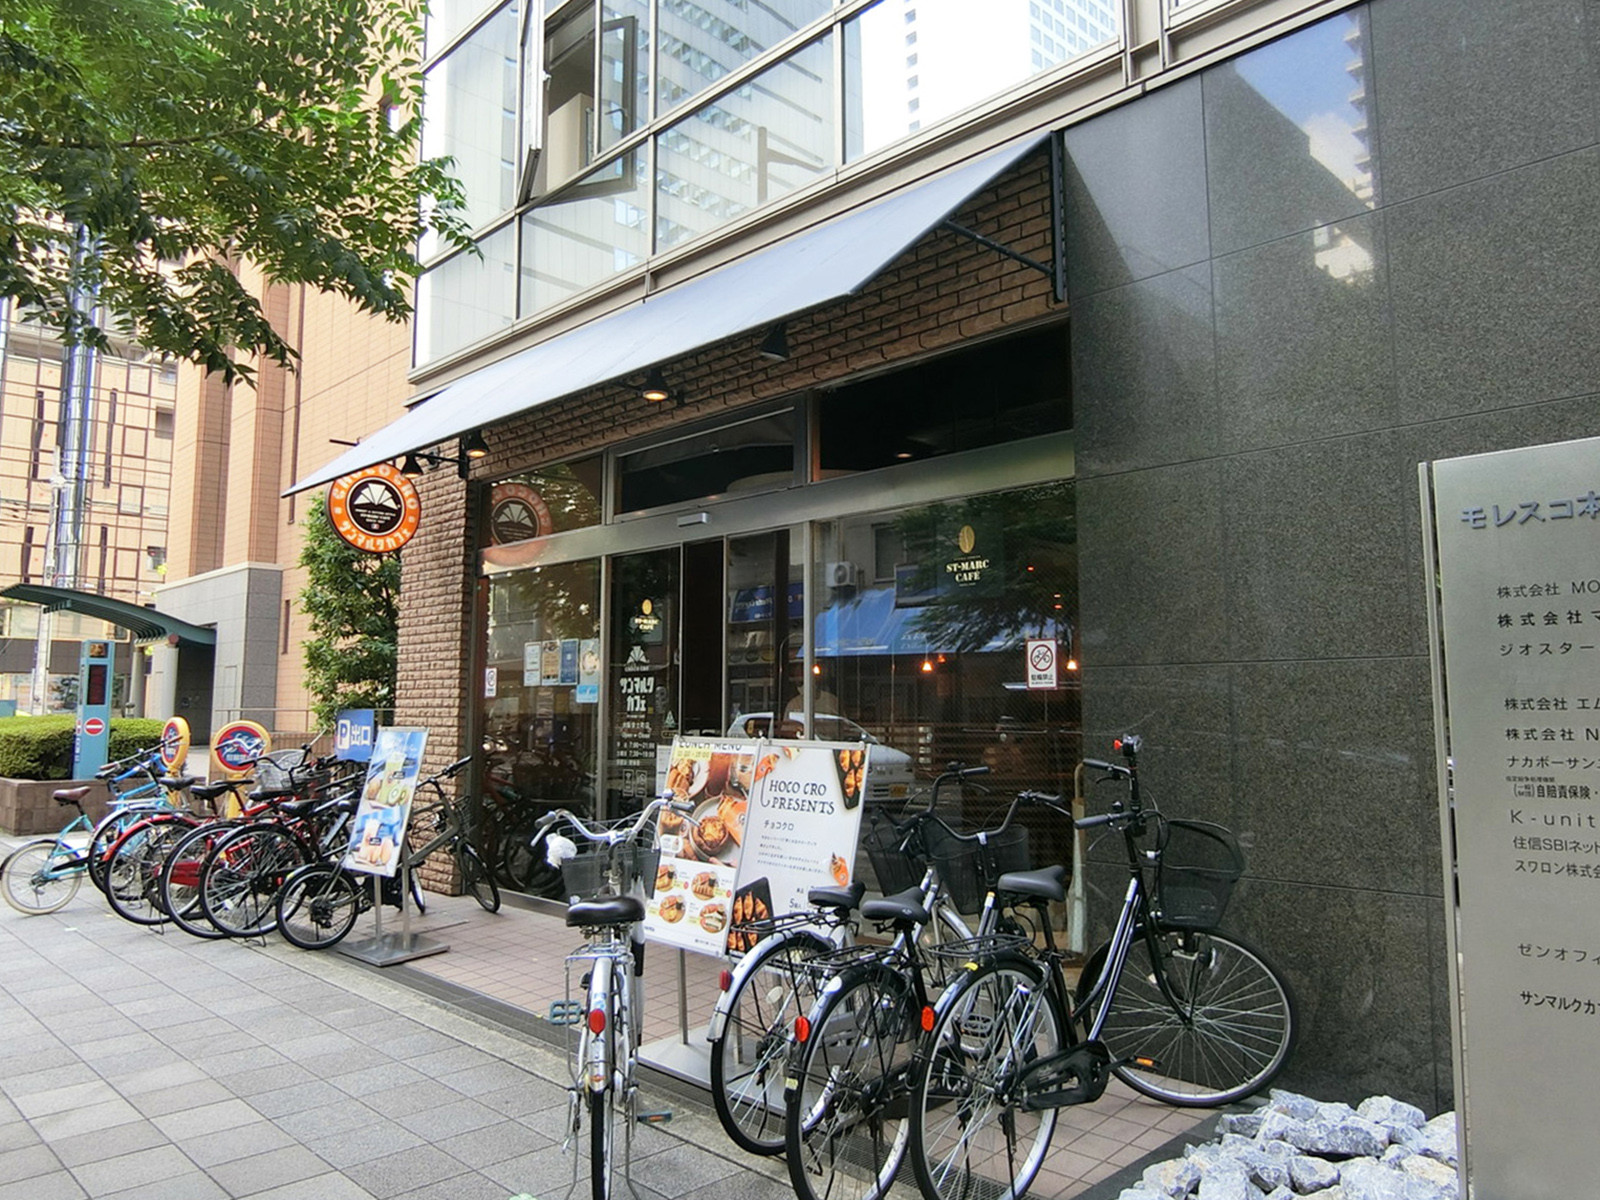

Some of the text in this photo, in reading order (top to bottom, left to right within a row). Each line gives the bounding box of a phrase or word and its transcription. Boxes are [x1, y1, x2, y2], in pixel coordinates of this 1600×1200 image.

[1461, 491, 1600, 529] モレスコ本
[1497, 579, 1600, 599] 株式会社 MO
[1500, 642, 1594, 656] ジオスター
[1504, 697, 1568, 710] 株式会社
[350, 724, 370, 746] 出口
[1505, 727, 1599, 741] 株式会社 N
[1506, 755, 1600, 769] ナカボーサン
[803, 782, 827, 796] CRO
[771, 796, 835, 815] PRESENTS
[763, 819, 795, 832] チョコクロ
[1520, 990, 1600, 1015] サンマルクカ
